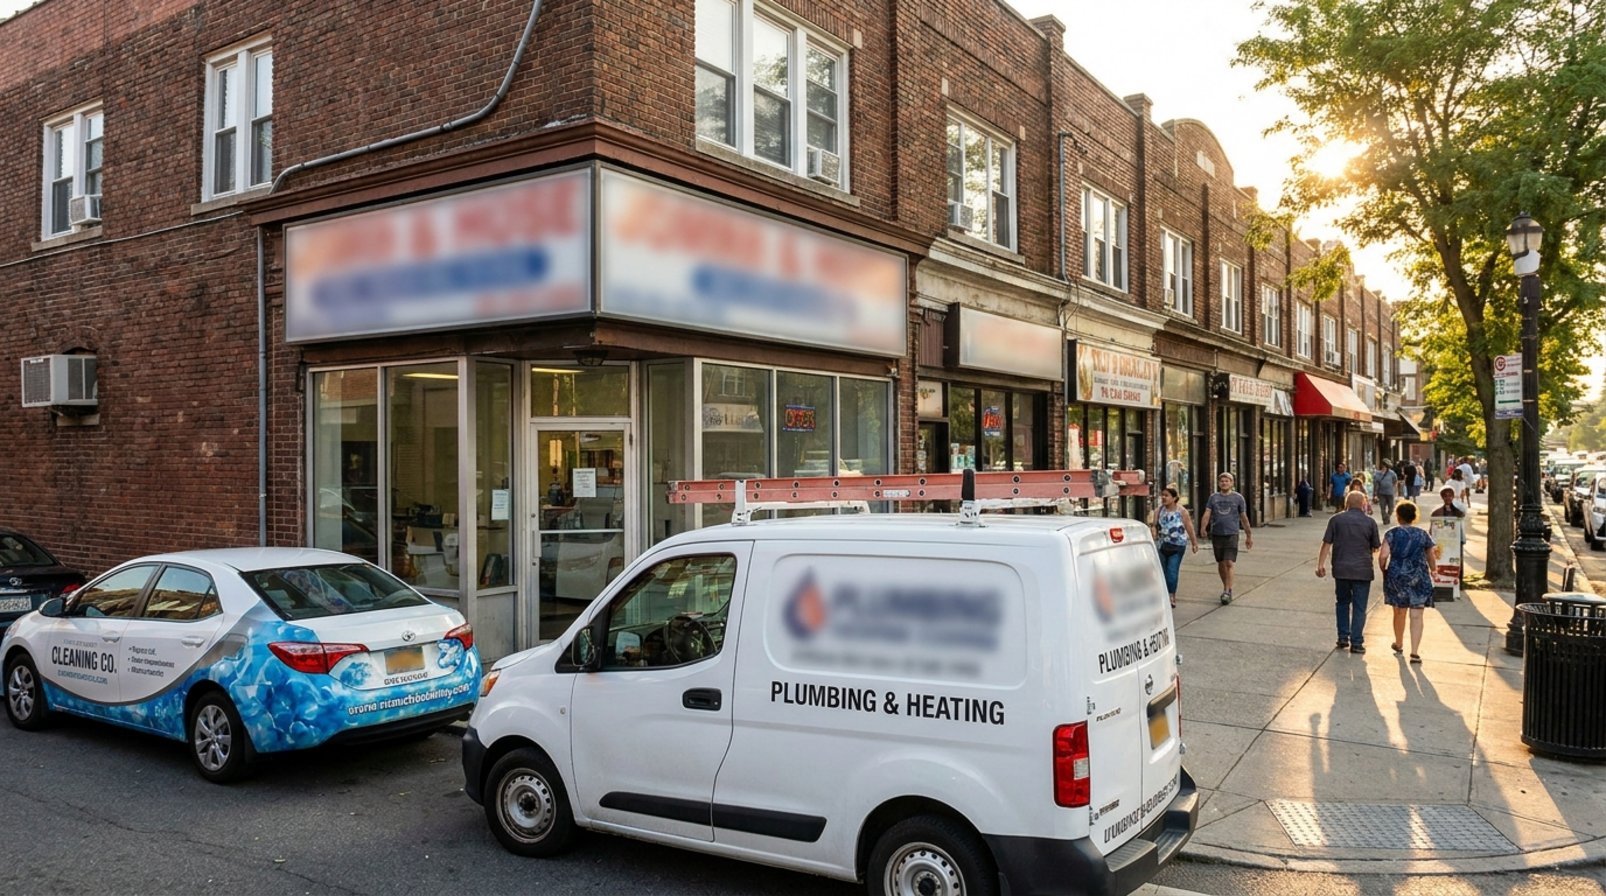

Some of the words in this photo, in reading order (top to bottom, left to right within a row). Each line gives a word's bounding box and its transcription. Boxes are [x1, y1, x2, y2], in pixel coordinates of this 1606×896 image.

[51, 645, 98, 670] CLEANING
[100, 652, 118, 674] CO.
[1098, 640, 1142, 674] PLUMBING
[771, 680, 877, 713] PLUMBING
[883, 691, 900, 715] &
[906, 693, 1005, 725] HEATING
